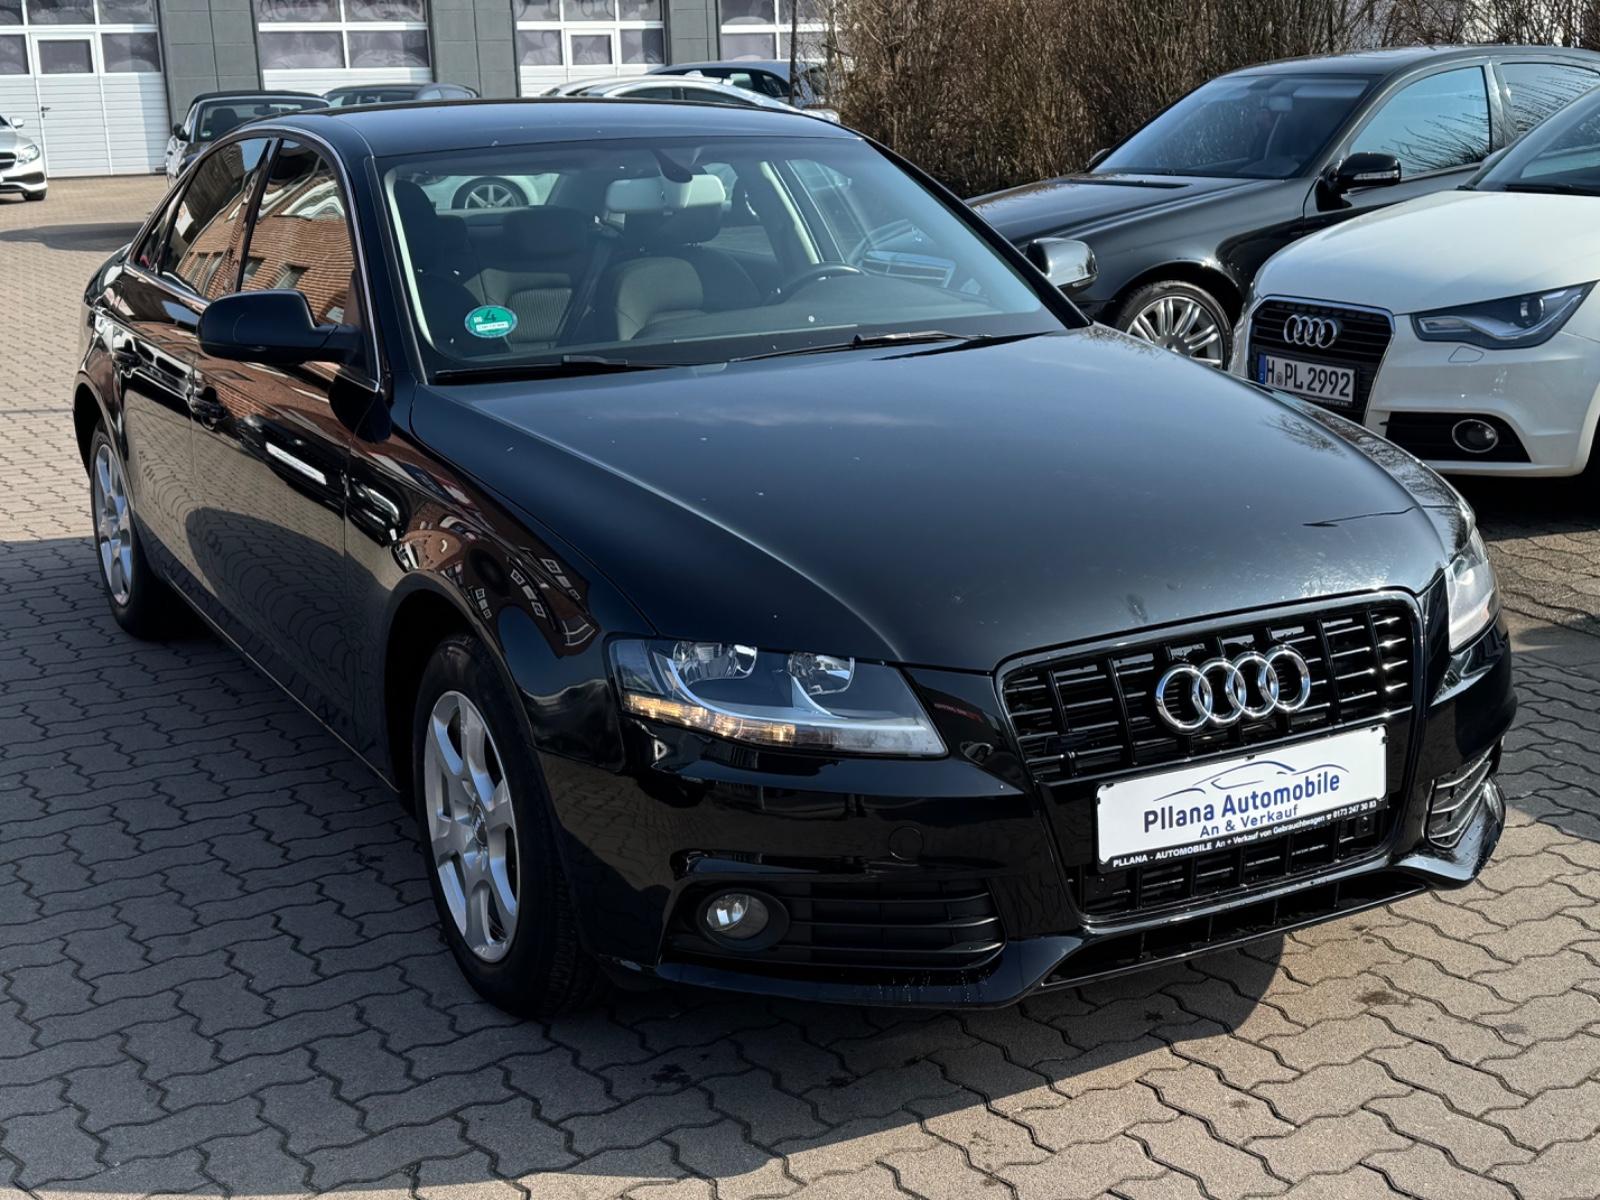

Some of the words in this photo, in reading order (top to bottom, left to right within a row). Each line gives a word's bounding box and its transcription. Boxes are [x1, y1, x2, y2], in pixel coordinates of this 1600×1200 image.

[483, 309, 497, 322] 4
[1265, 359, 1275, 384] H
[1285, 363, 1303, 390] PL
[1307, 367, 1351, 397] 2992
[1144, 804, 1214, 833] Pllana
[1221, 771, 1340, 818] Automobile
[1200, 825, 1219, 838] An
[1225, 819, 1236, 832] &
[1240, 804, 1299, 828] Verkauf
[1113, 854, 1148, 867] PLLANA
[1155, 842, 1212, 859] AUTOMOBILE
[1215, 840, 1226, 848] An
[1233, 831, 1258, 844] Verkauf
[1259, 828, 1273, 838] von
[1273, 815, 1325, 834] Gebrauchtwagen
[1332, 807, 1348, 819] 0173
[1359, 801, 1369, 811] 30
